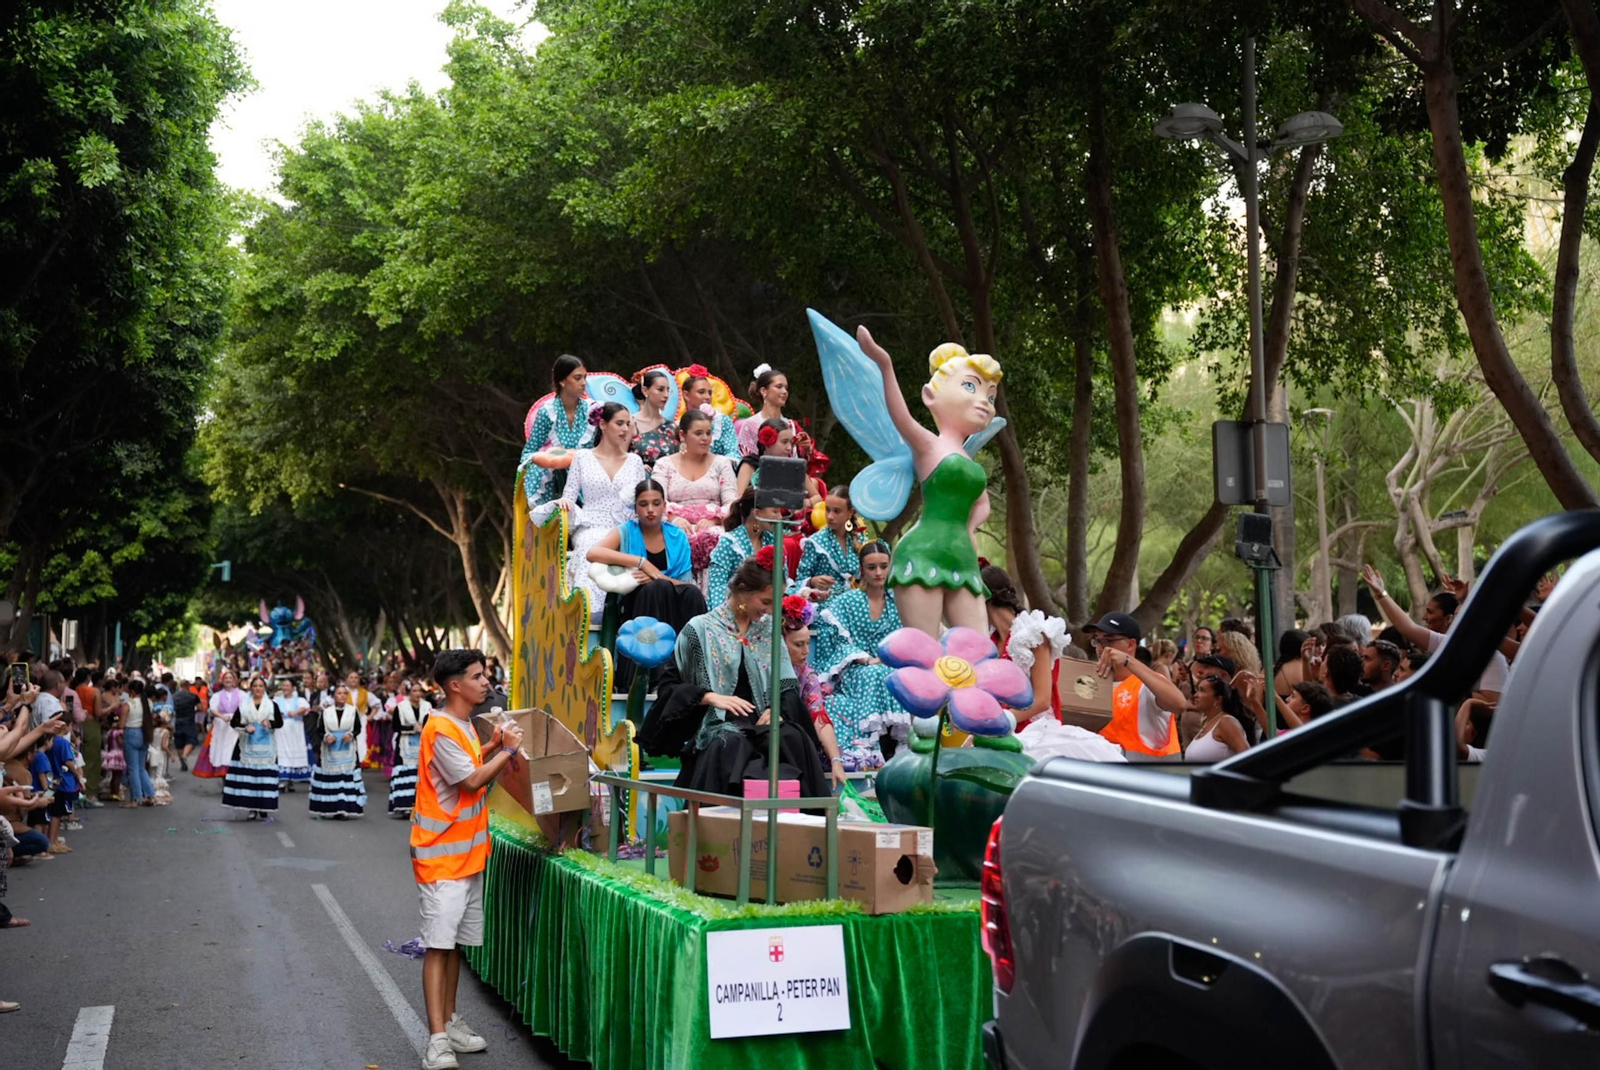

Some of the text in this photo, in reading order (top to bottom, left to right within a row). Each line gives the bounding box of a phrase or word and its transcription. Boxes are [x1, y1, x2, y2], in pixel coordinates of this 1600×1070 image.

[716, 981, 780, 1004] CAMPANILLA
[787, 978, 819, 999] PETER
[820, 976, 841, 997] PAN
[776, 1002, 783, 1022] 2
